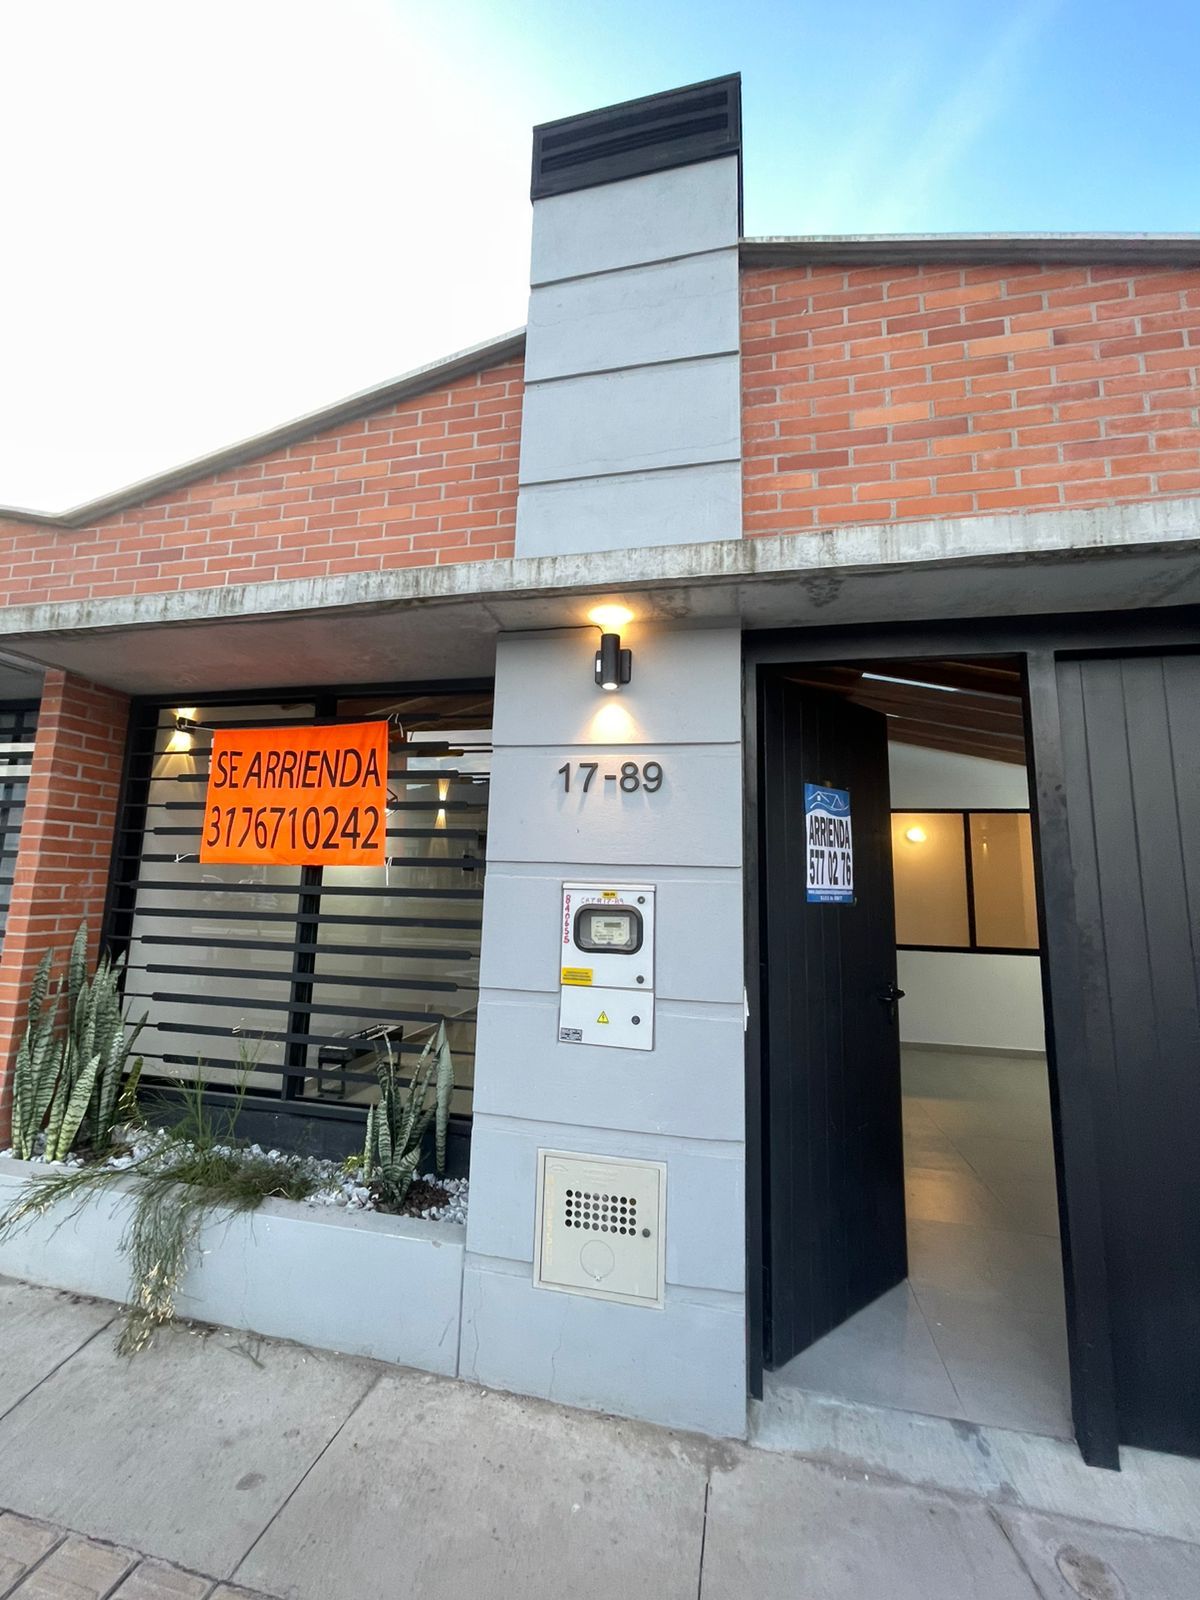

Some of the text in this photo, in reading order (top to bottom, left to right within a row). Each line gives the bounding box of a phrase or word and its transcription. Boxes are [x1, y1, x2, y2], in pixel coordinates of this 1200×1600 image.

[213, 748, 381, 789] SE ARRIENDA
[558, 761, 663, 793] 17-89
[206, 805, 379, 850] 3176710242
[808, 814, 851, 849] ARRIENDA
[809, 849, 852, 886] 577 02 76
